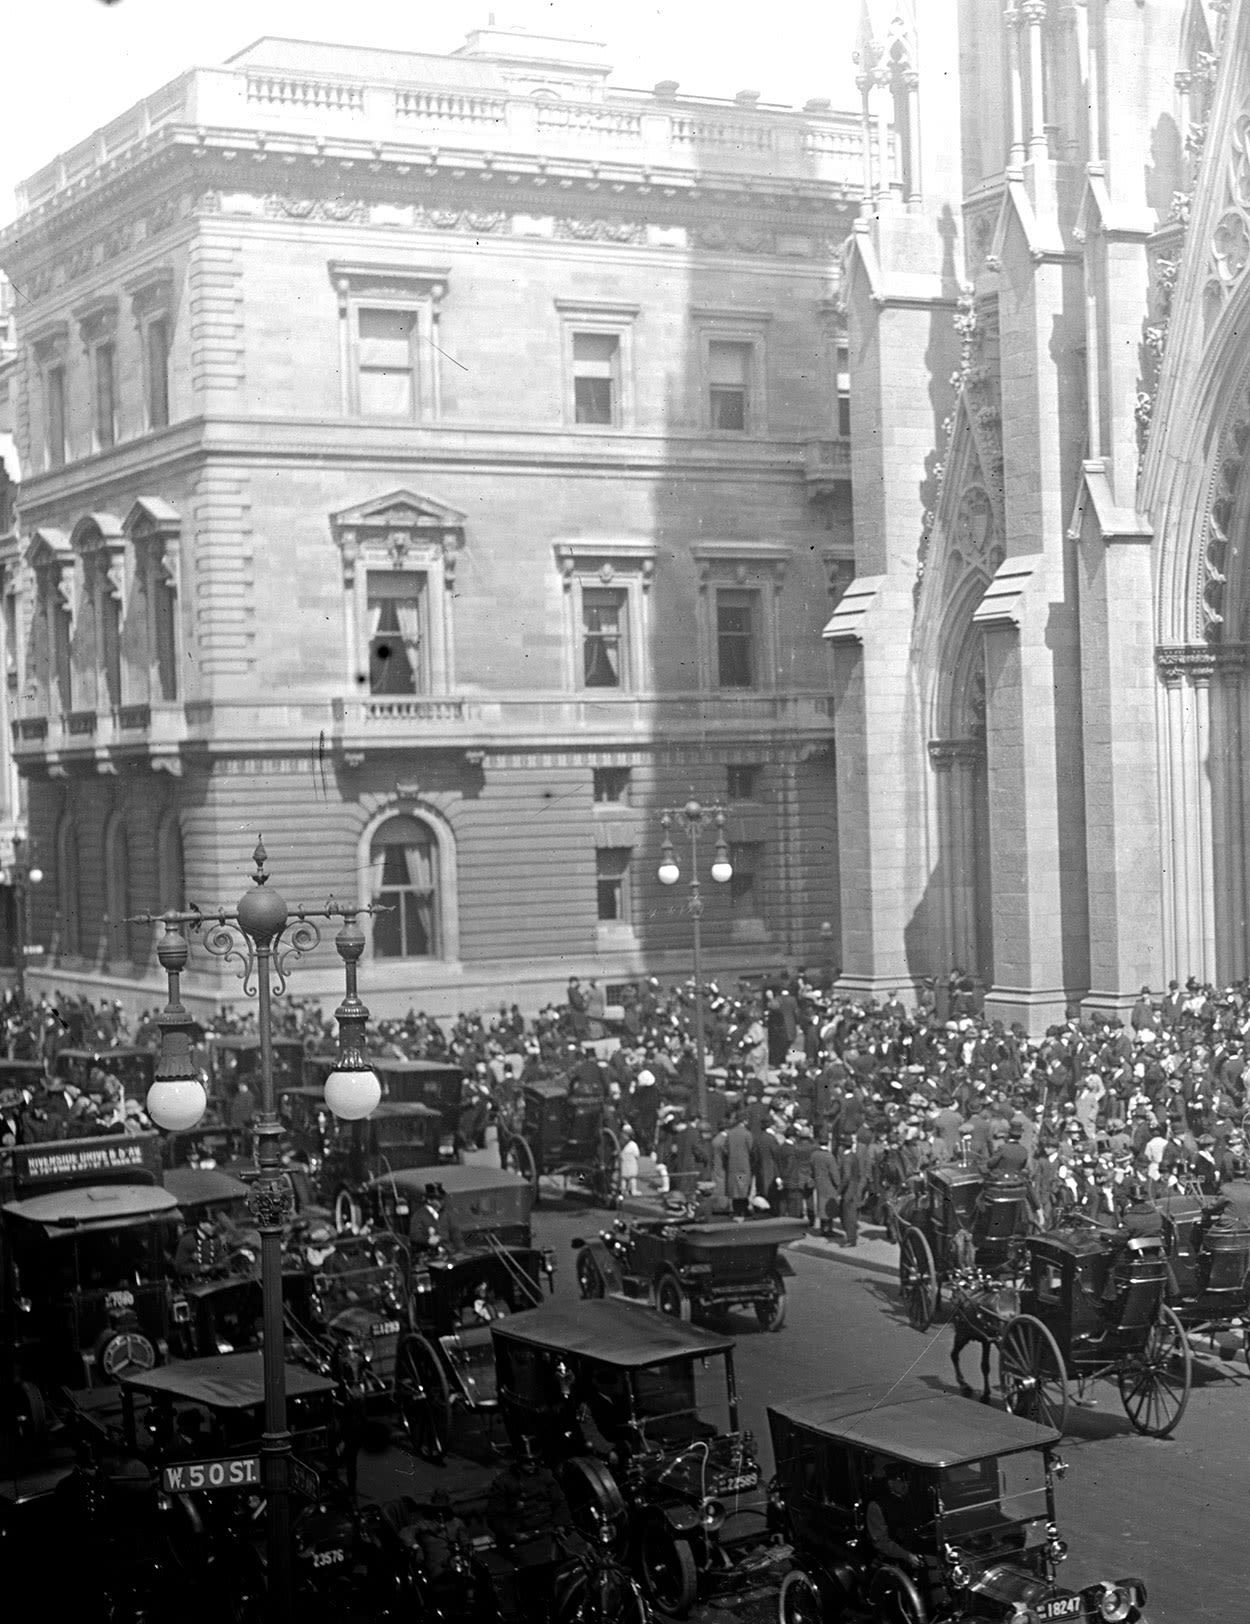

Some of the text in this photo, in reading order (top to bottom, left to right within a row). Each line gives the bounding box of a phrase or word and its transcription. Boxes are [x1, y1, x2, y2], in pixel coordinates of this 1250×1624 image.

[166, 1459, 257, 1489] W. 50 ST.
[1048, 1596, 1080, 1618] 18247
